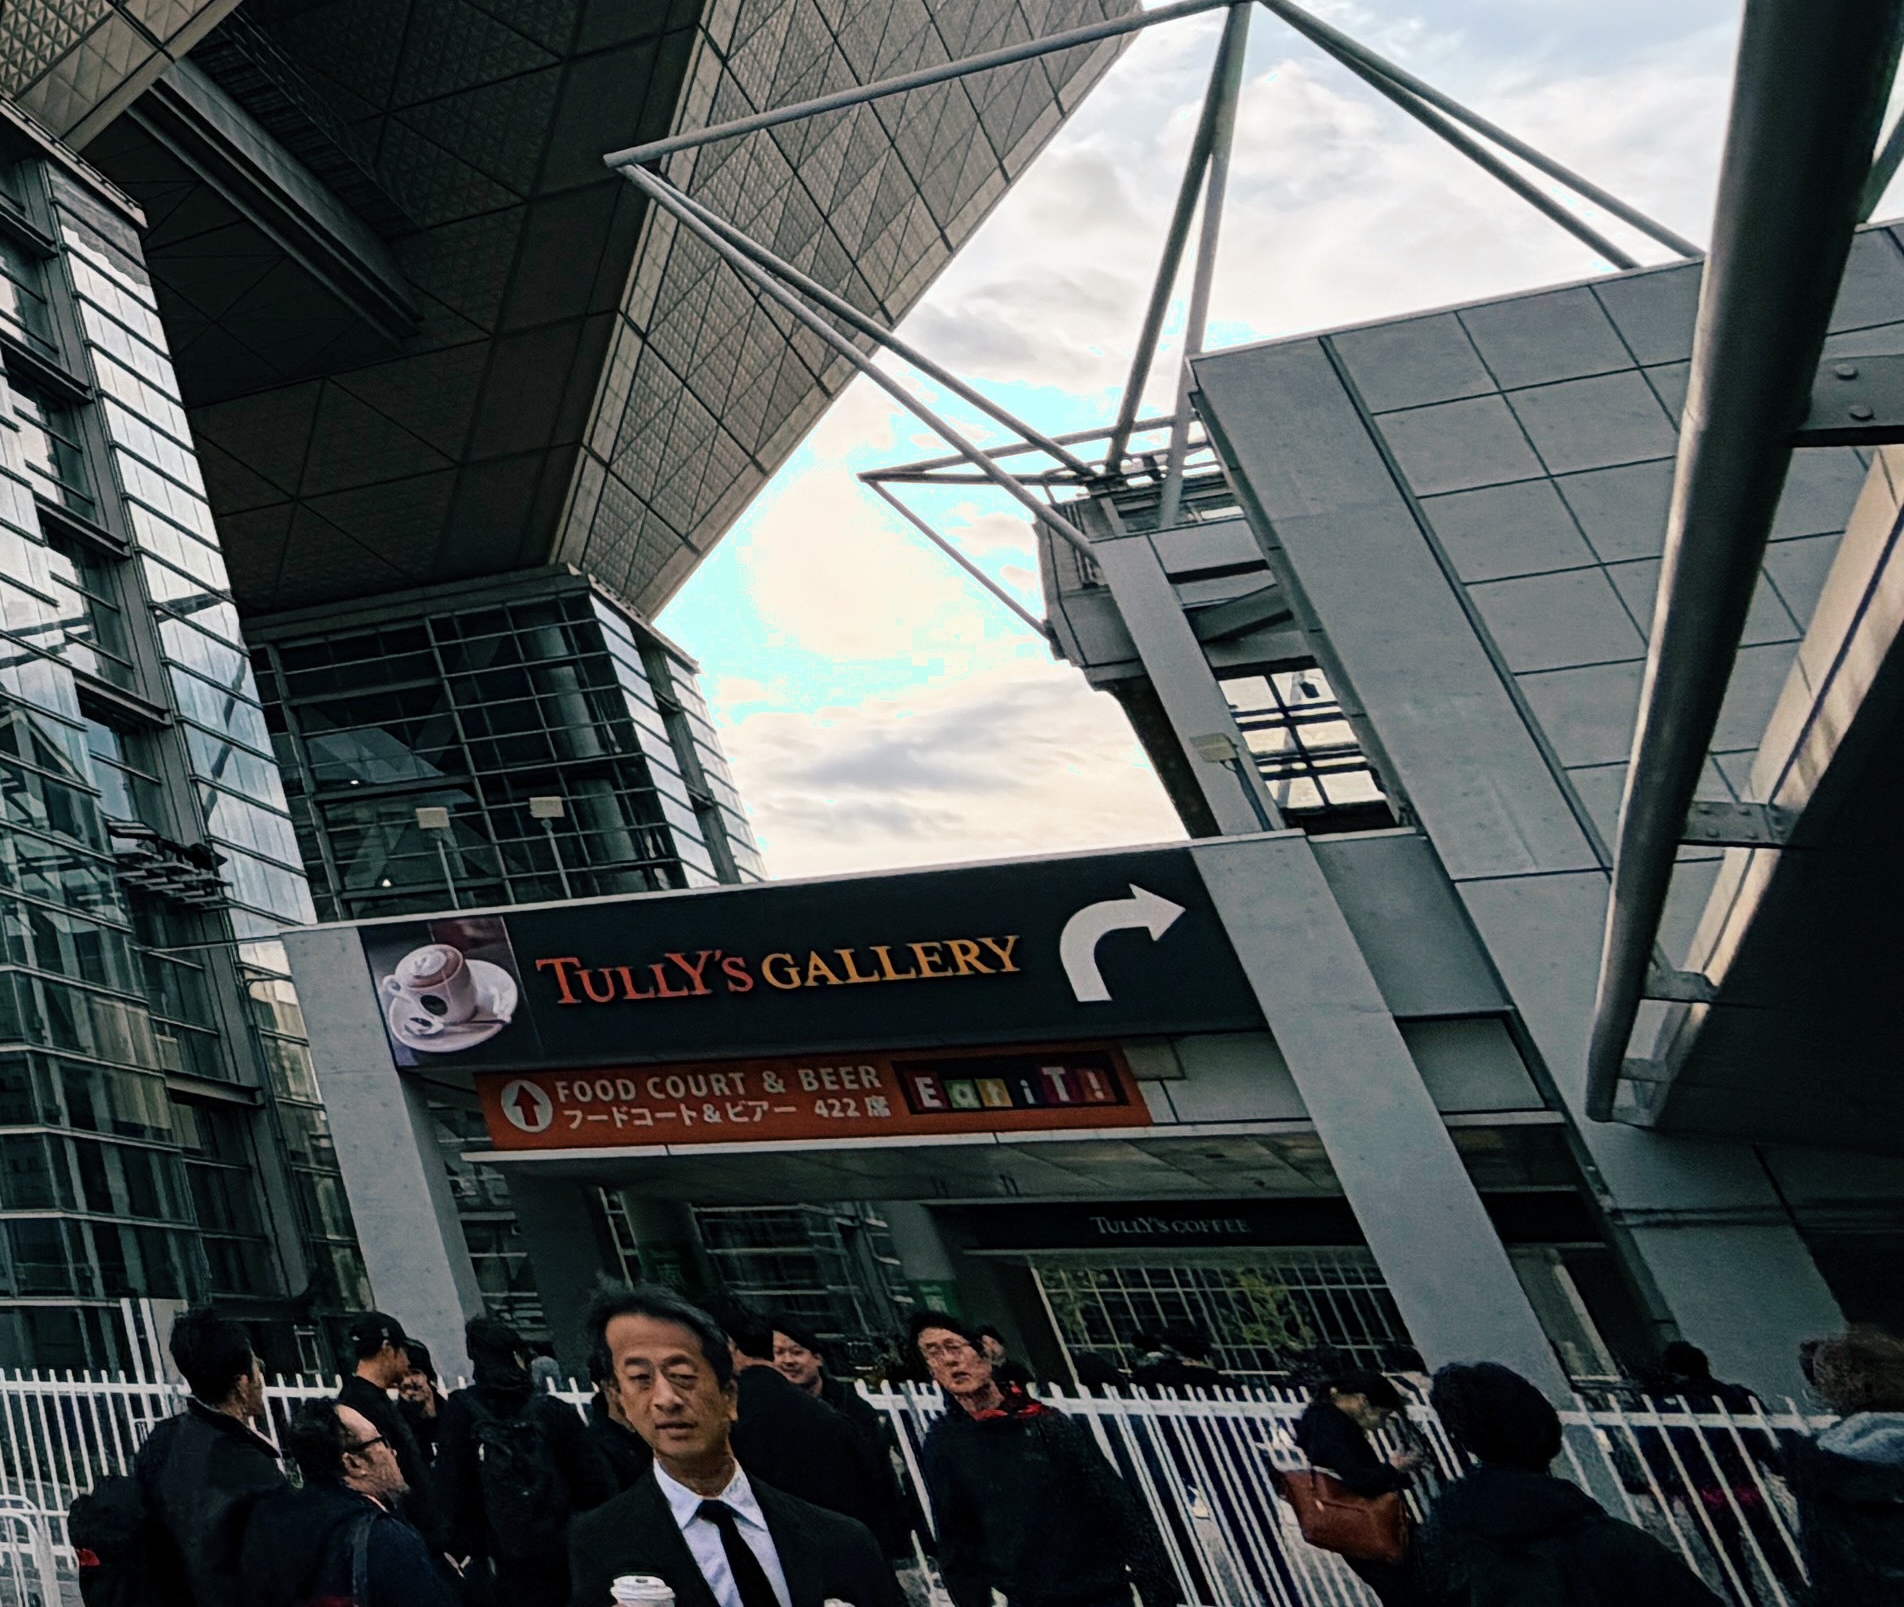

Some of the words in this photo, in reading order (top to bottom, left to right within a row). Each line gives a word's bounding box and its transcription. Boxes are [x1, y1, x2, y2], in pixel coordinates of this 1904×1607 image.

[535, 949, 755, 1005] TULLY'S
[760, 934, 1022, 990] GALLERY
[555, 1077, 636, 1103] FOOD
[646, 1071, 746, 1100] COURT
[762, 1069, 786, 1094] &
[797, 1064, 883, 1092] BEER
